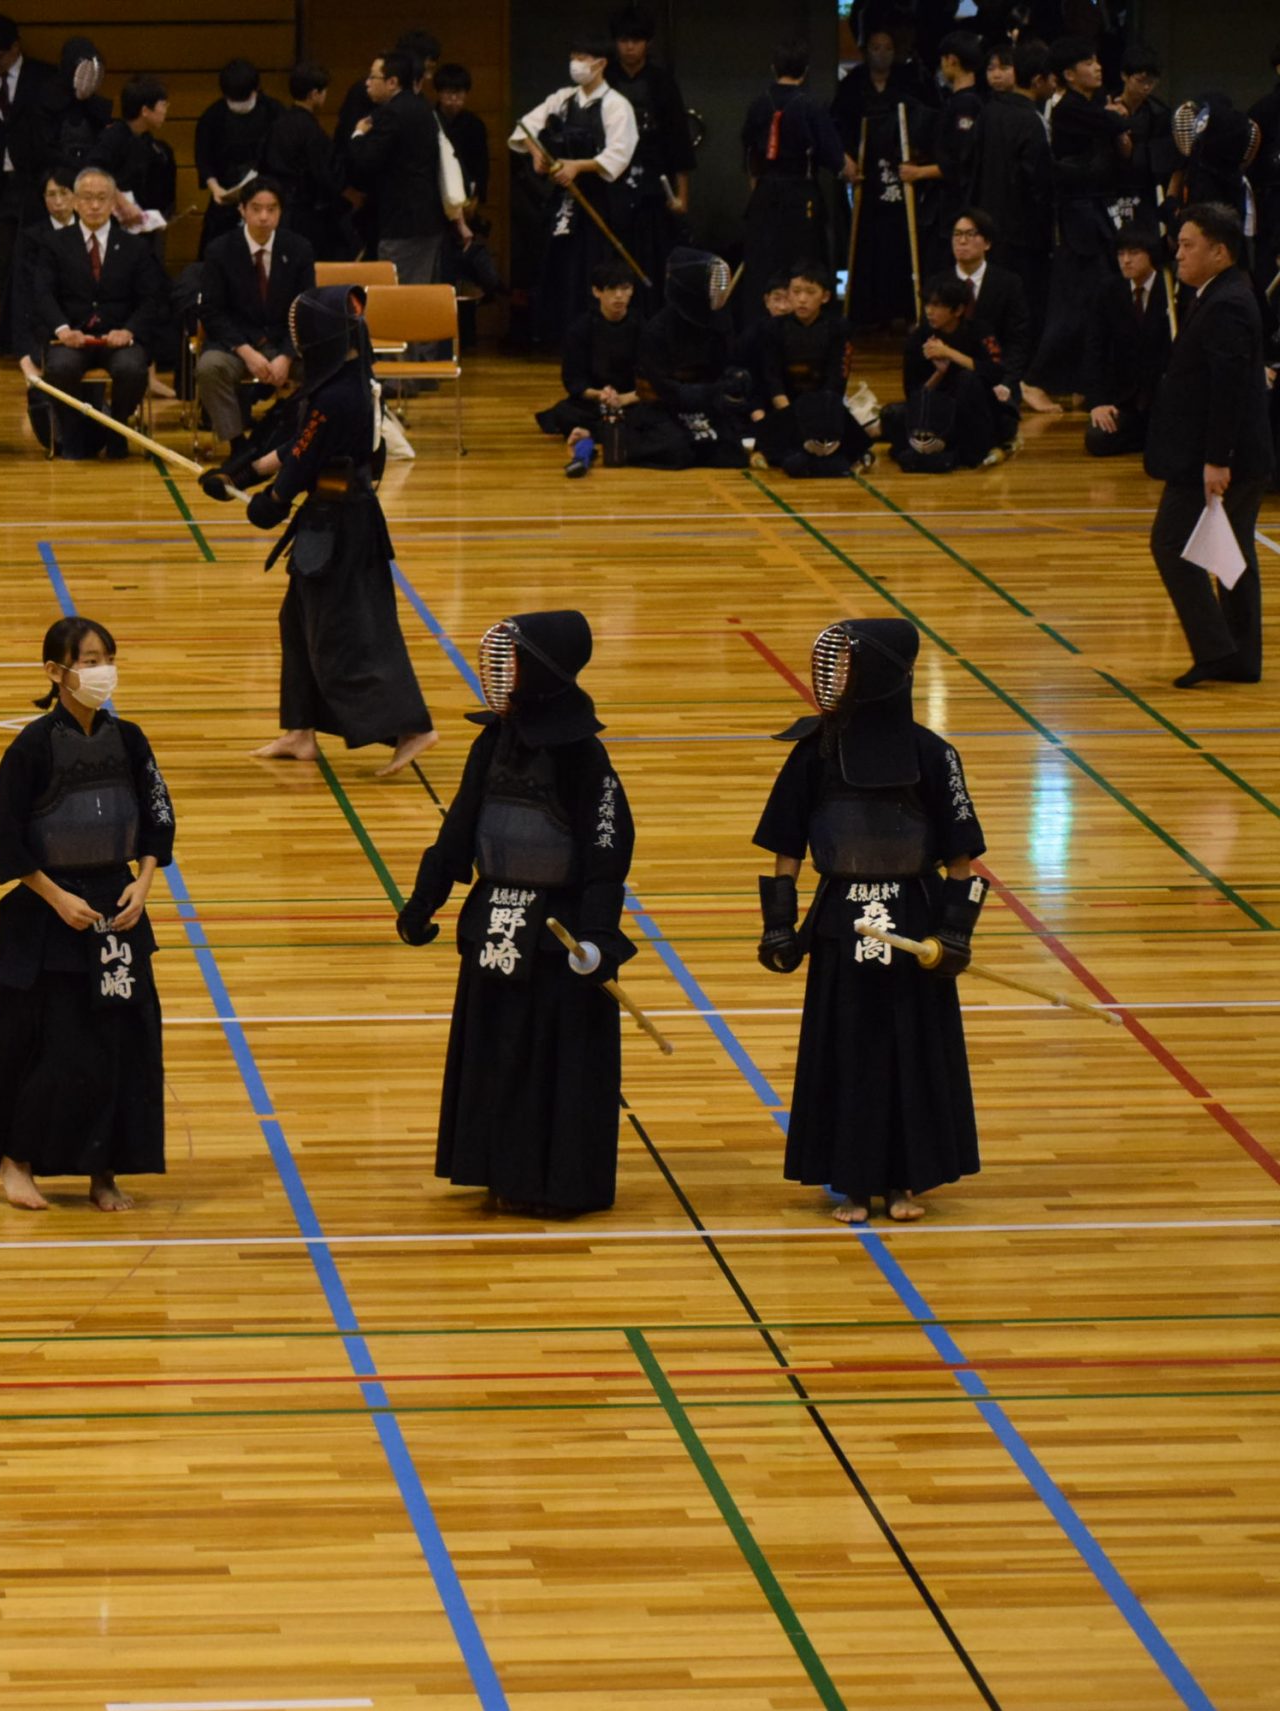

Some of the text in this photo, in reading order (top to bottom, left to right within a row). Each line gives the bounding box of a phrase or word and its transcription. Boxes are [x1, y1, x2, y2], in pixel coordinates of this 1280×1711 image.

[593, 790, 617, 849] 尾張旭東
[489, 887, 537, 907] 尾張旭東中
[845, 882, 901, 902] 尾張旭東中
